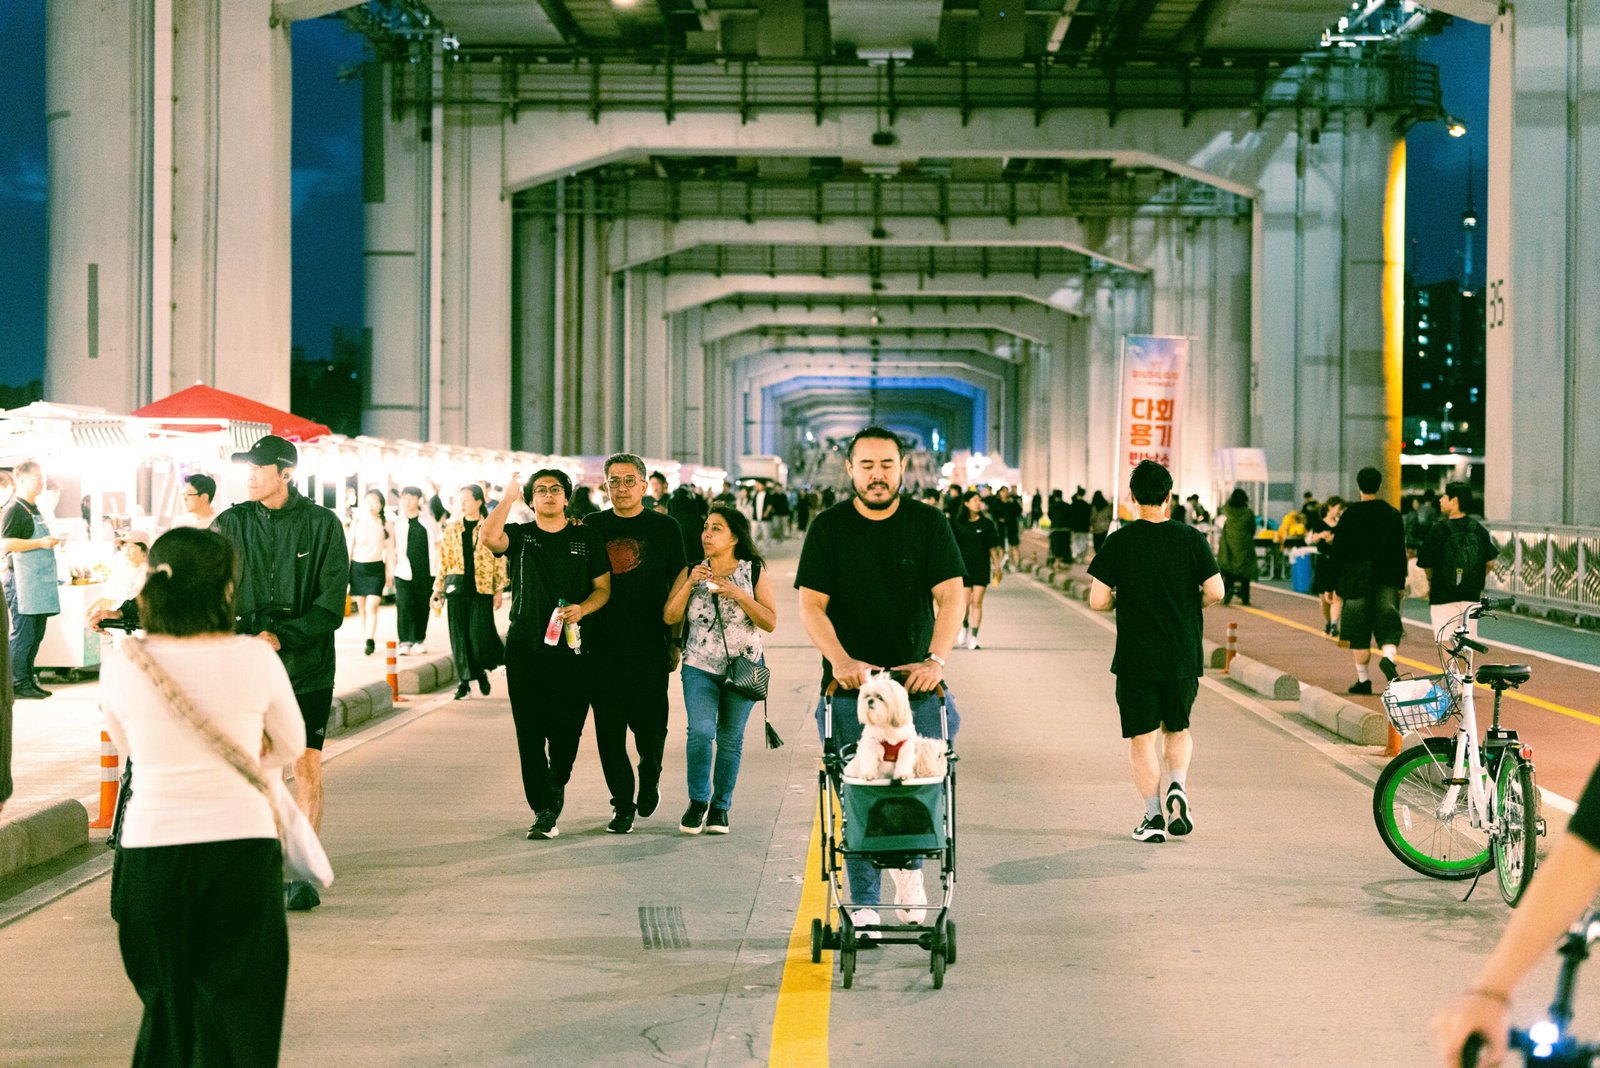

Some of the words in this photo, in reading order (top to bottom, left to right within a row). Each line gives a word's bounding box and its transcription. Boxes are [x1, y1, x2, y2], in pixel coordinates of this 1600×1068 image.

[1490, 279, 1504, 329] 35
[1131, 398, 1174, 421] 다회
[1130, 424, 1172, 448] 용기
